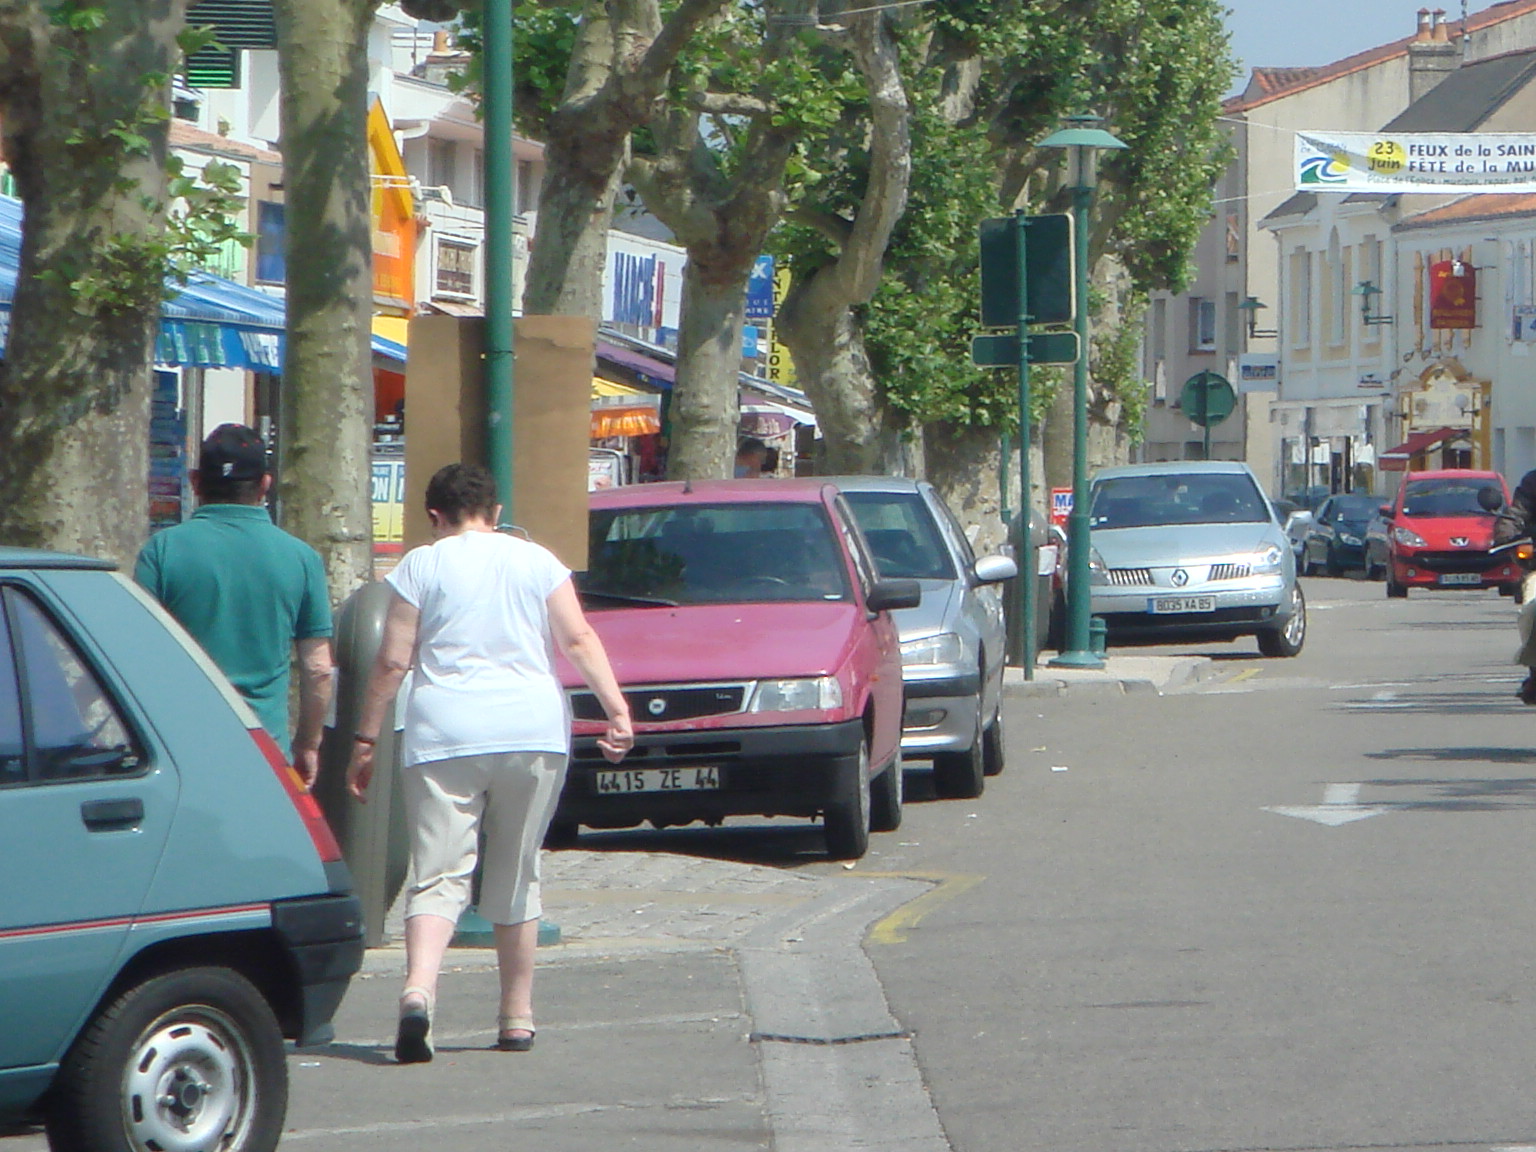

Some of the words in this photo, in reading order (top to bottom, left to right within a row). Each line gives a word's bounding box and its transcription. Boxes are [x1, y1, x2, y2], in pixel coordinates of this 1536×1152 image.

[1375, 141, 1394, 155] 23
[1409, 144, 1448, 157] FEUX
[1455, 144, 1473, 157] de
[1478, 144, 1491, 157] la
[1409, 158, 1447, 173] FÊTE
[1455, 160, 1474, 174] de
[1483, 160, 1498, 173] la
[600, 772, 644, 792] 4415
[660, 769, 682, 789] ZE
[695, 768, 717, 788] 44
